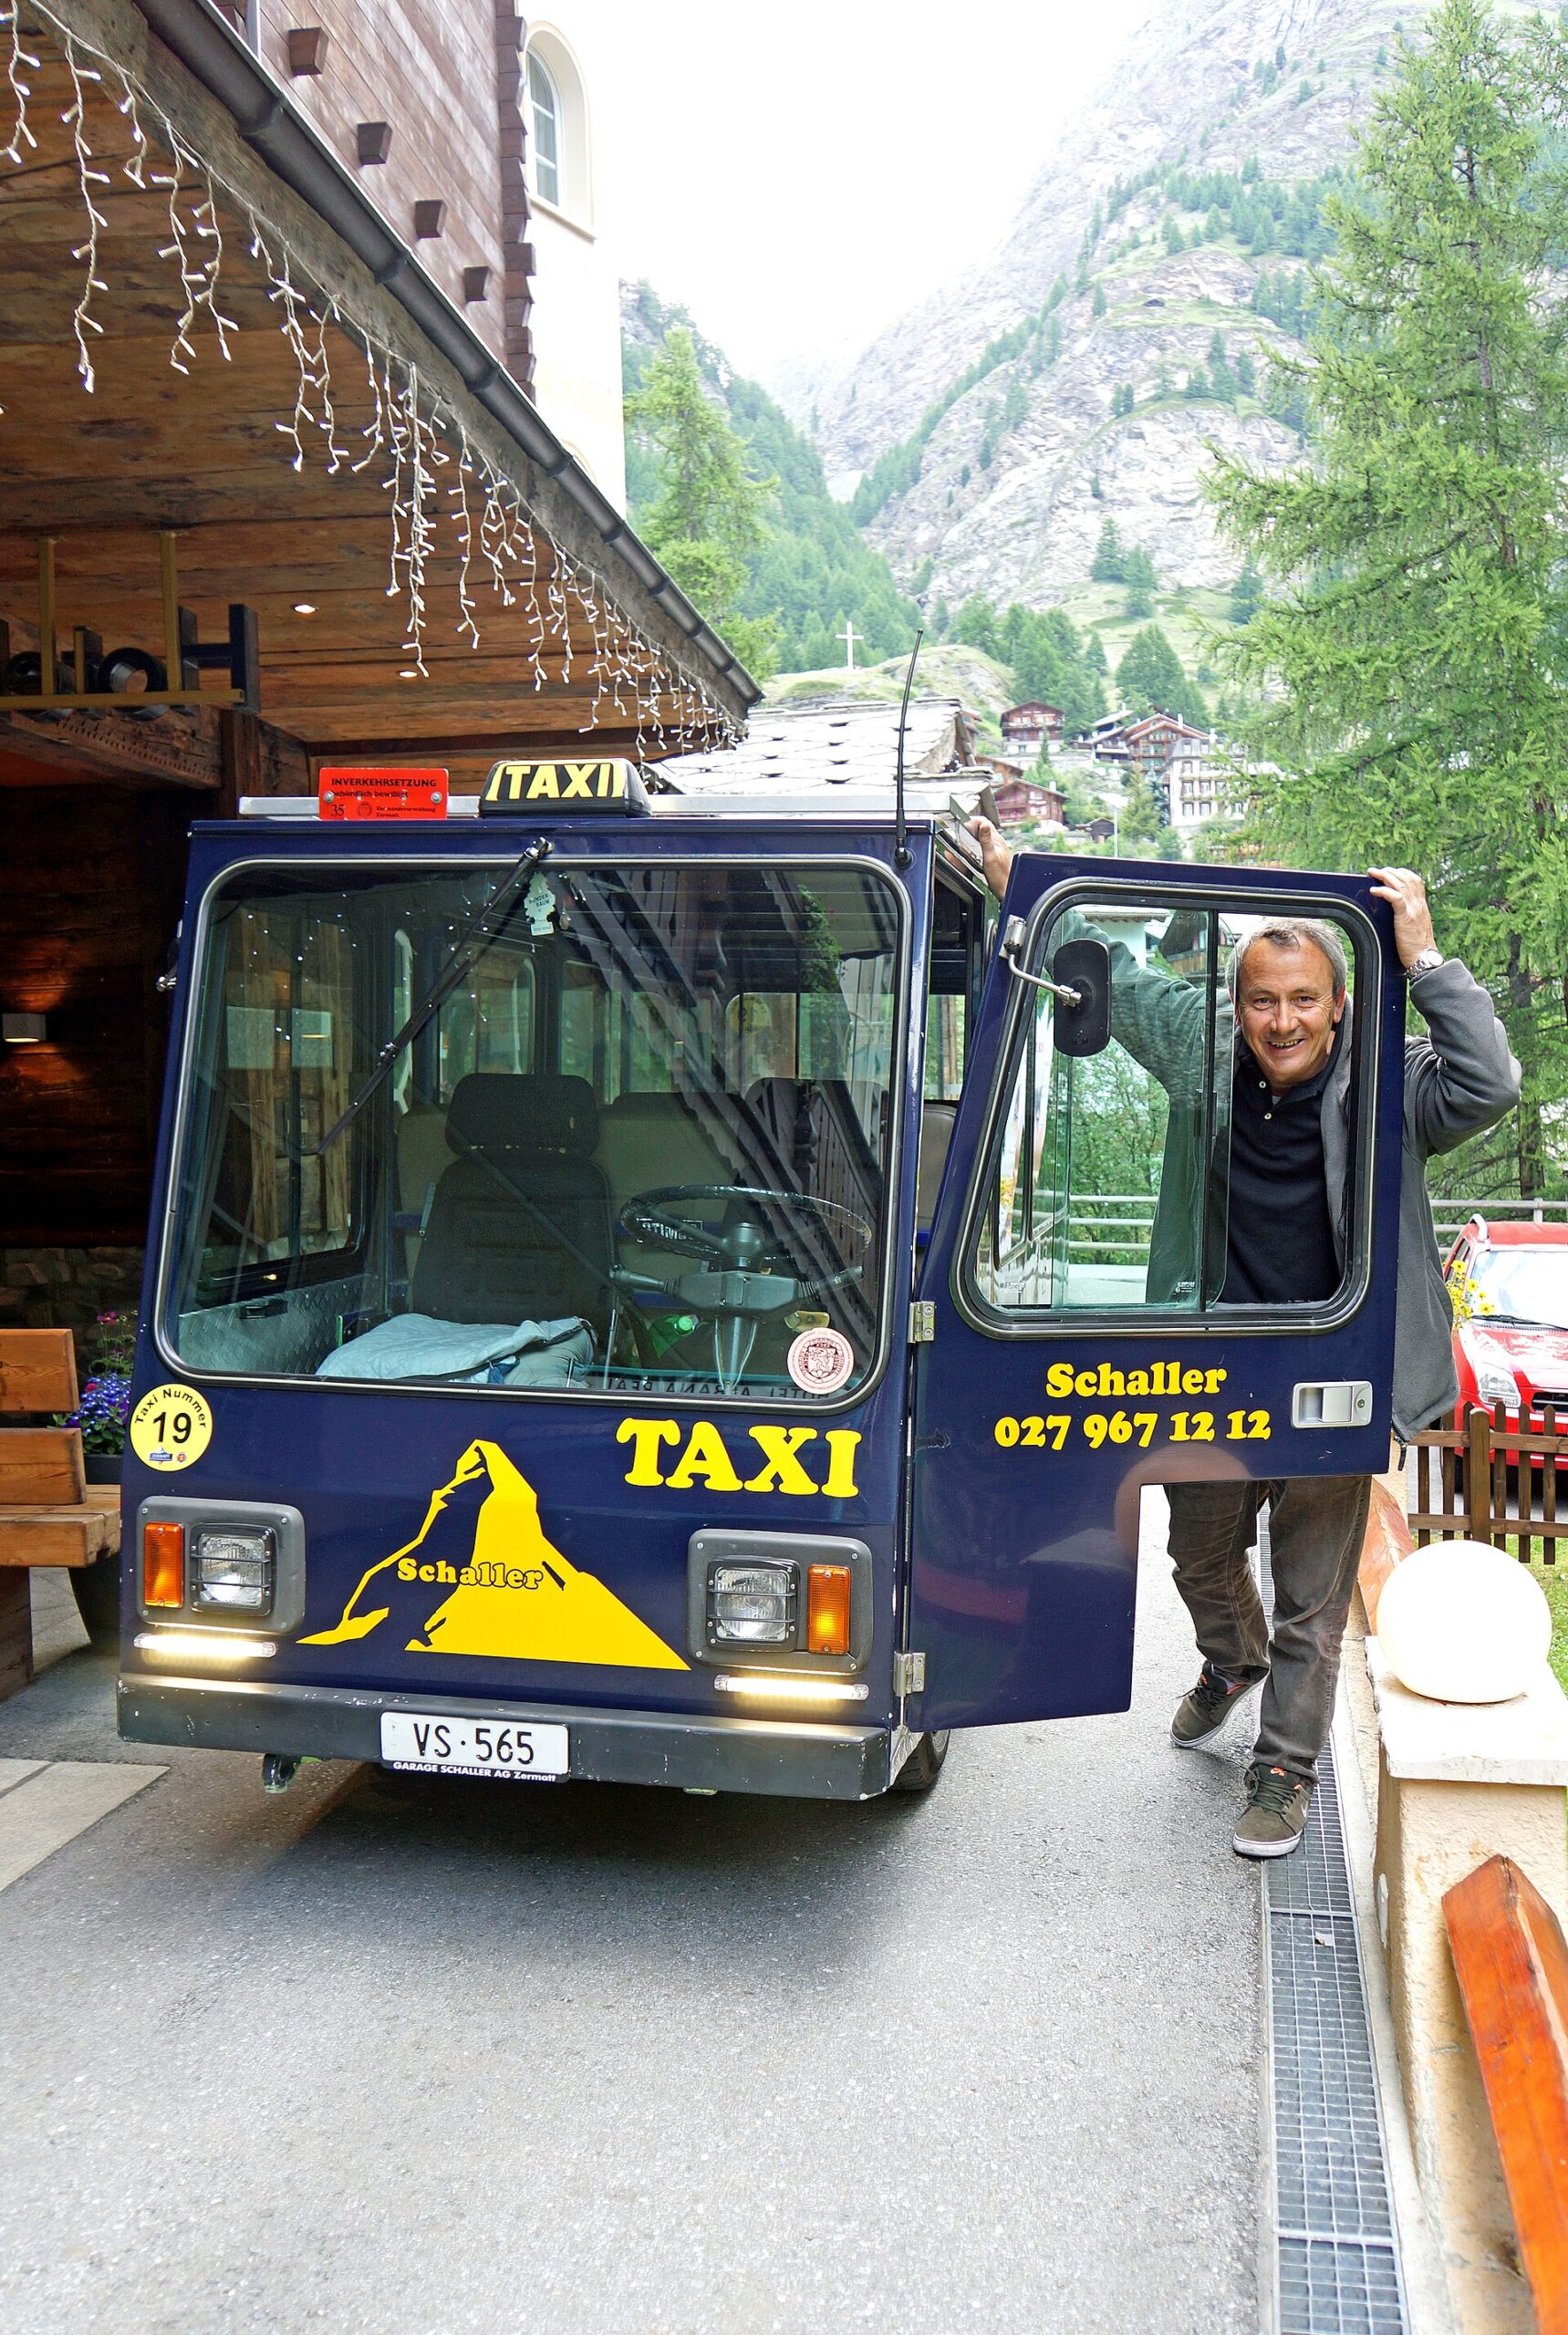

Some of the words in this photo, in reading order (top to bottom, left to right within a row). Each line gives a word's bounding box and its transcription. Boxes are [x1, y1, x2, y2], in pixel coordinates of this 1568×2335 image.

[331, 778, 437, 787] INVERKEHRSETZUNG
[505, 763, 611, 800] TAXI
[331, 804, 345, 817] 35
[1045, 1361, 1228, 1398] Schaller
[134, 1395, 159, 1424] Taxi
[162, 1388, 206, 1428] Nummer
[152, 1411, 192, 1444] 19
[994, 1415, 1072, 1451] 027
[1083, 1410, 1158, 1449] 967
[1169, 1411, 1216, 1442] 12
[1226, 1409, 1272, 1441] 12
[616, 1417, 863, 1499] TAXI
[397, 1558, 544, 1590] Schaller
[393, 1761, 438, 1773] GARAGE
[440, 1765, 492, 1778] SCHALLER
[493, 1769, 511, 1779] AG
[514, 1771, 556, 1782] Zermatt
